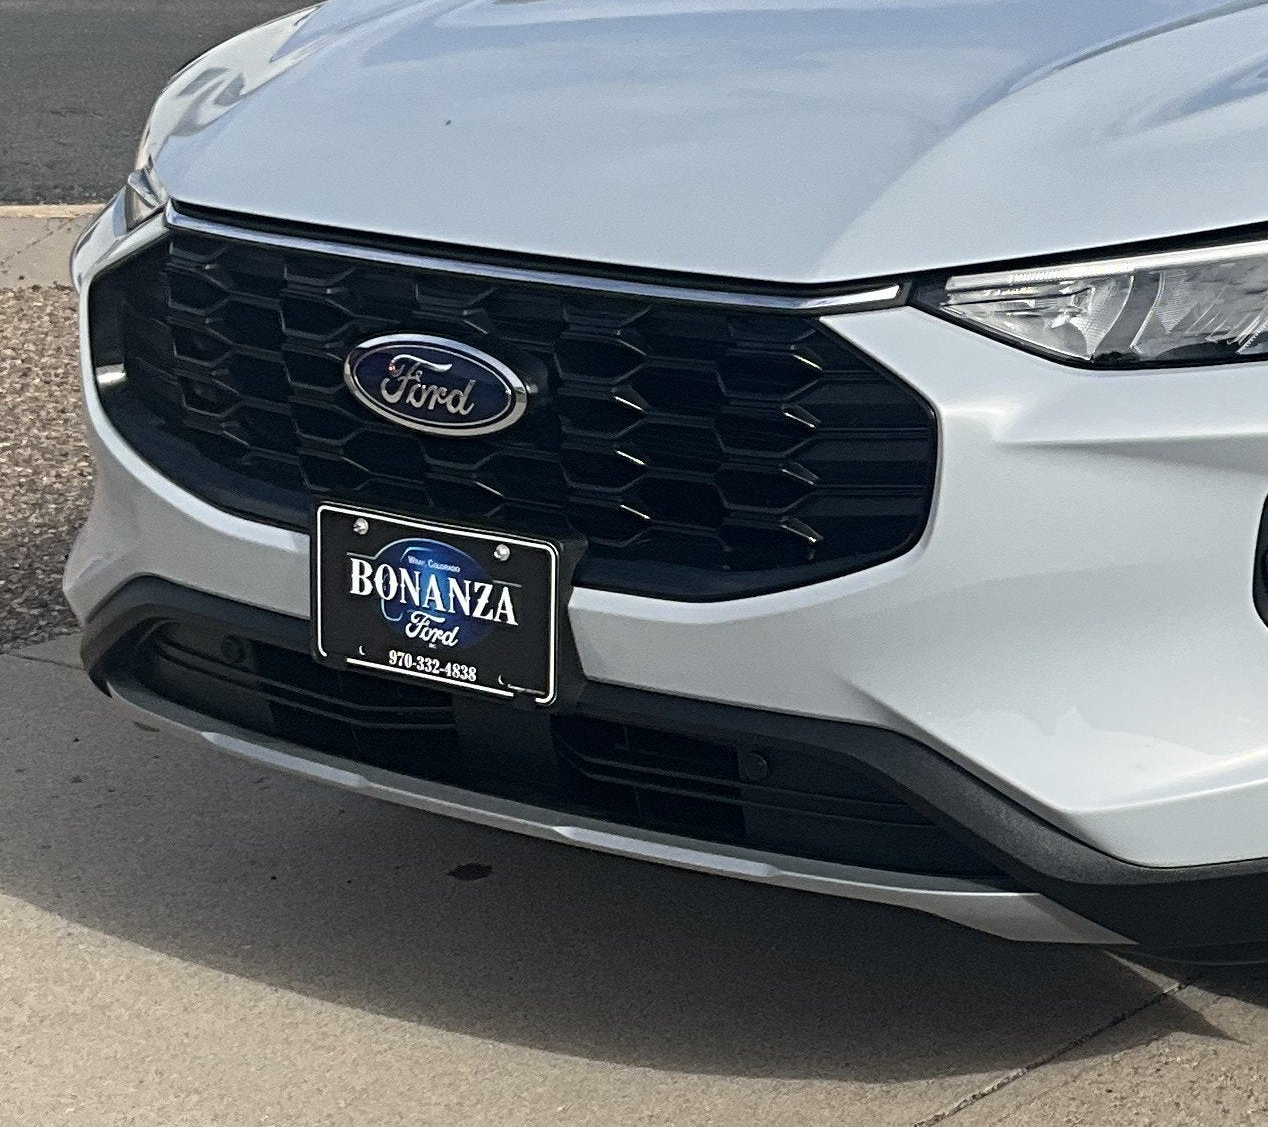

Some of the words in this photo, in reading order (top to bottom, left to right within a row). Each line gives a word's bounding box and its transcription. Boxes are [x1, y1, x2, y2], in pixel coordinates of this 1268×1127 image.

[380, 353, 477, 416] Ford
[350, 557, 519, 626] BONANZA
[405, 610, 460, 647] Ford
[388, 649, 477, 682] 970-332-4838
